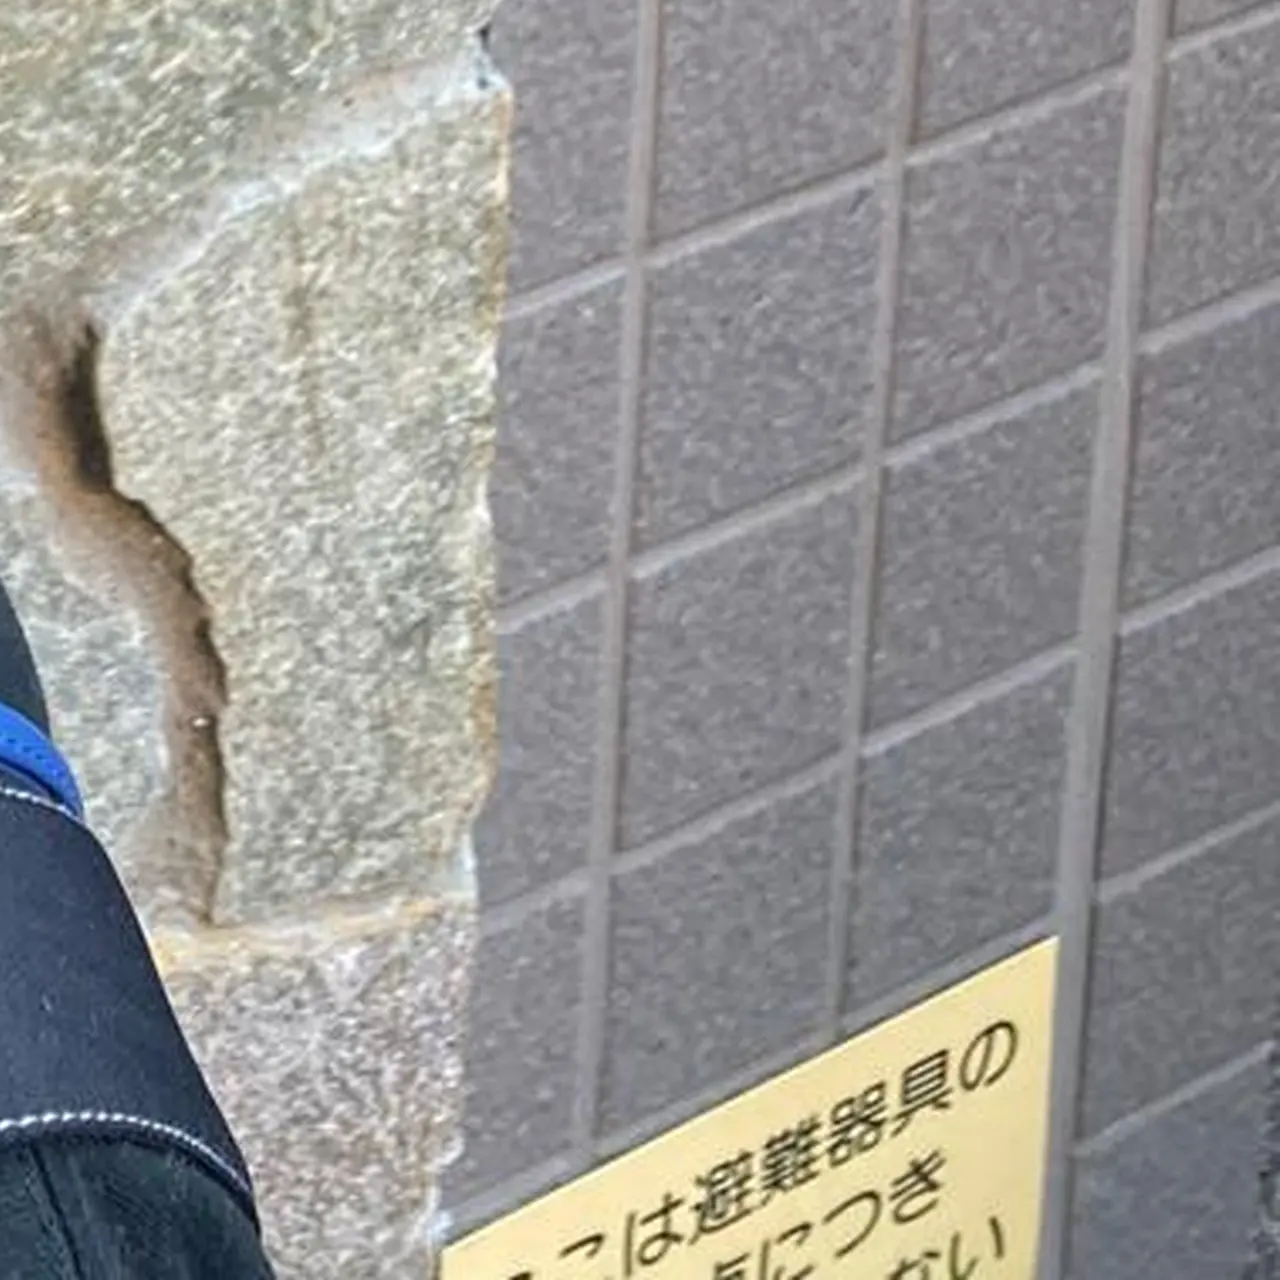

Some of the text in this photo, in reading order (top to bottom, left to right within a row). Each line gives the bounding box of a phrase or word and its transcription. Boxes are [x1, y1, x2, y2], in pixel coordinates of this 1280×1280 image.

[509, 1020, 1018, 1280] こは避難器具の
